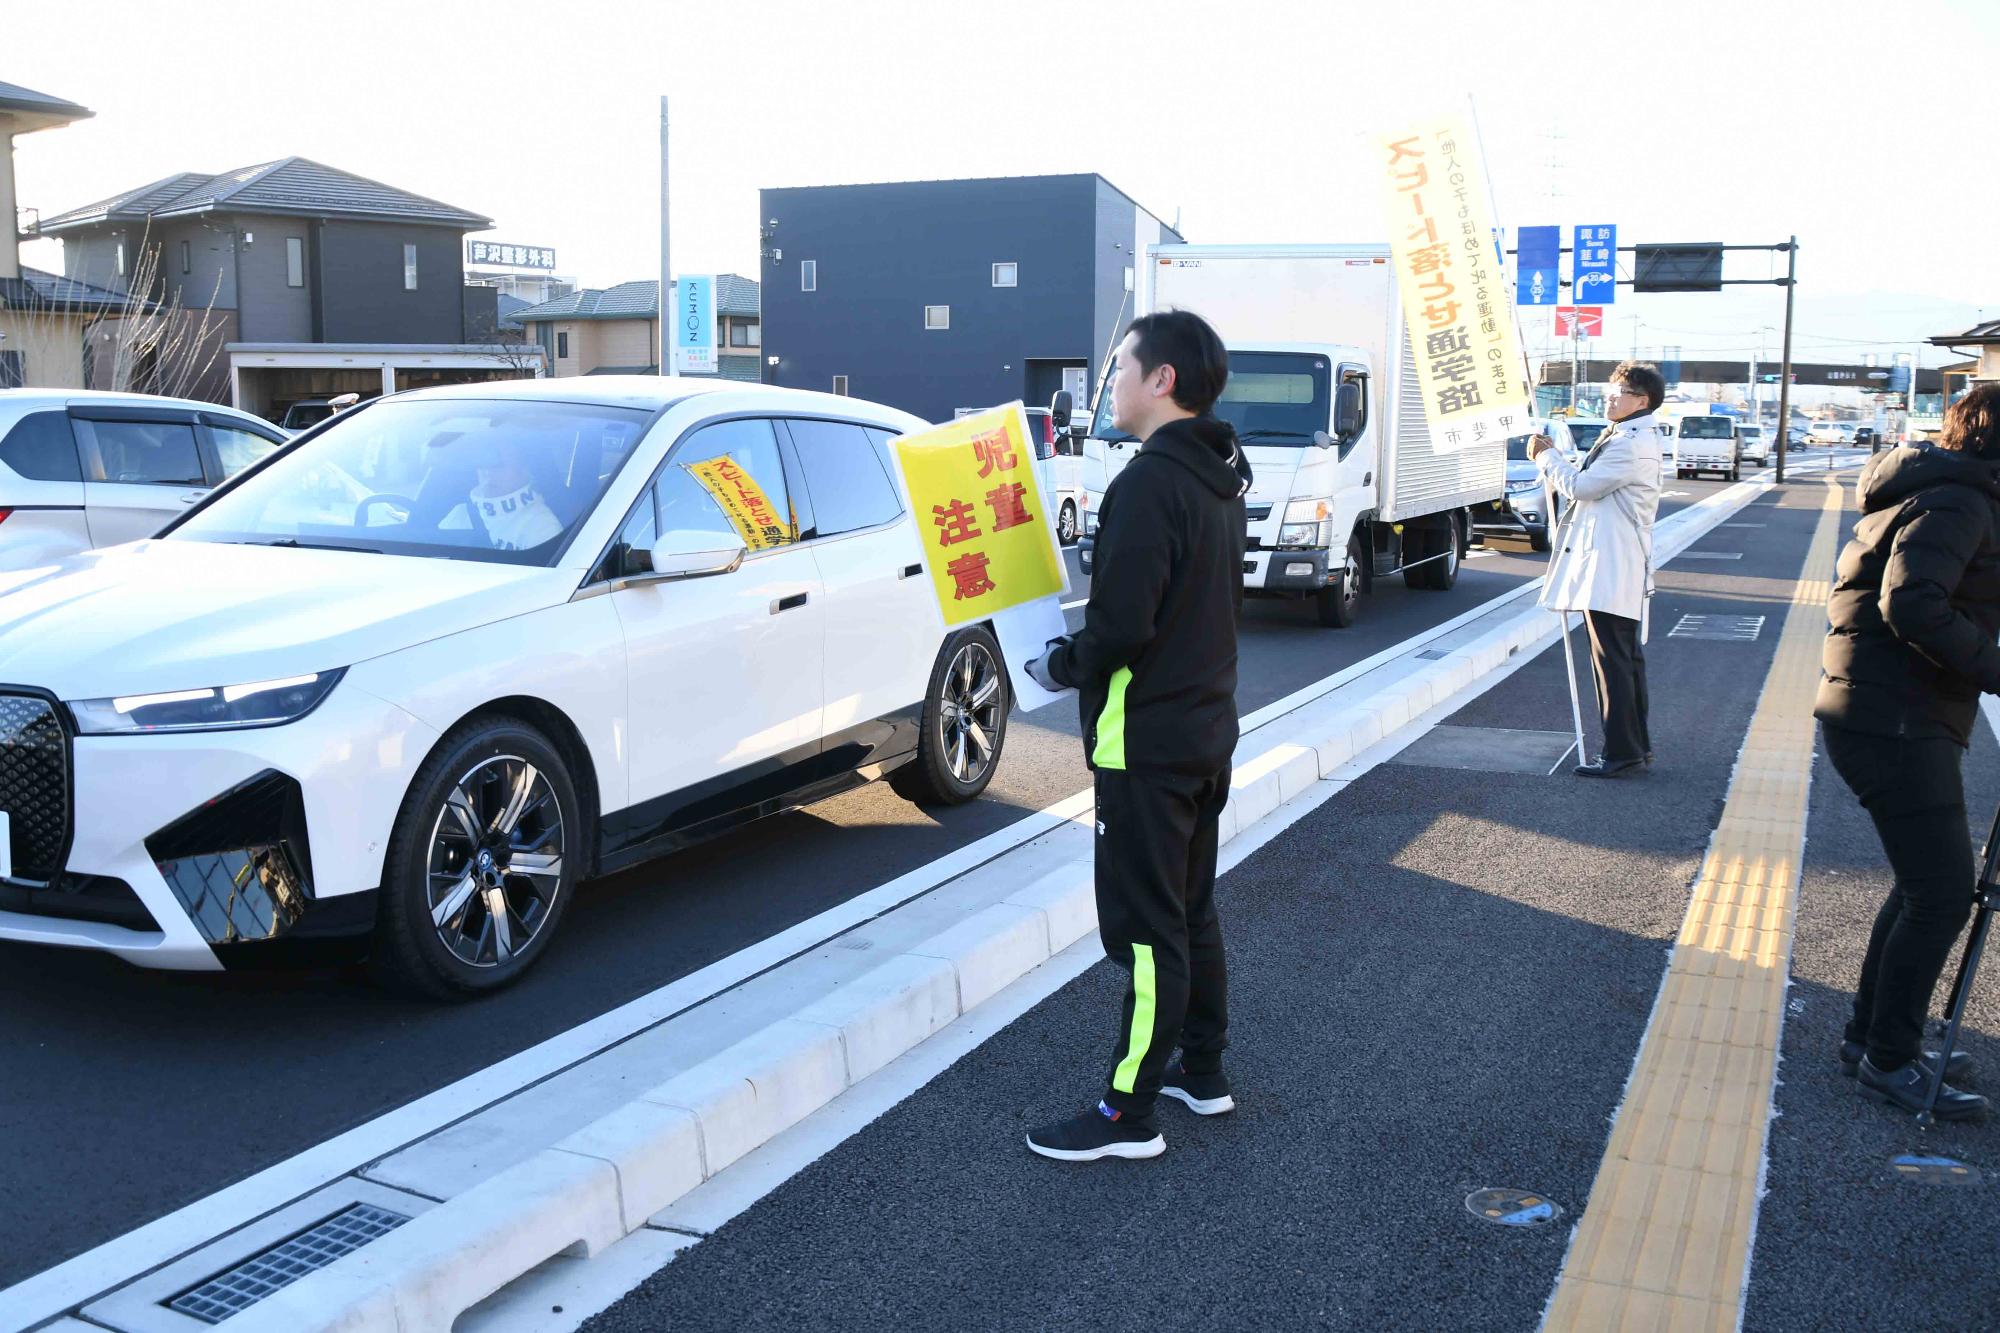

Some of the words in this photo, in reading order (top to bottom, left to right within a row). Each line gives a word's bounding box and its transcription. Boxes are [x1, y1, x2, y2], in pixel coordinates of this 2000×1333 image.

[473, 243, 554, 268] 芦沢整形外科
[687, 282, 700, 342] KUMON
[971, 426, 1034, 532] 児童
[932, 499, 996, 601] 注意
